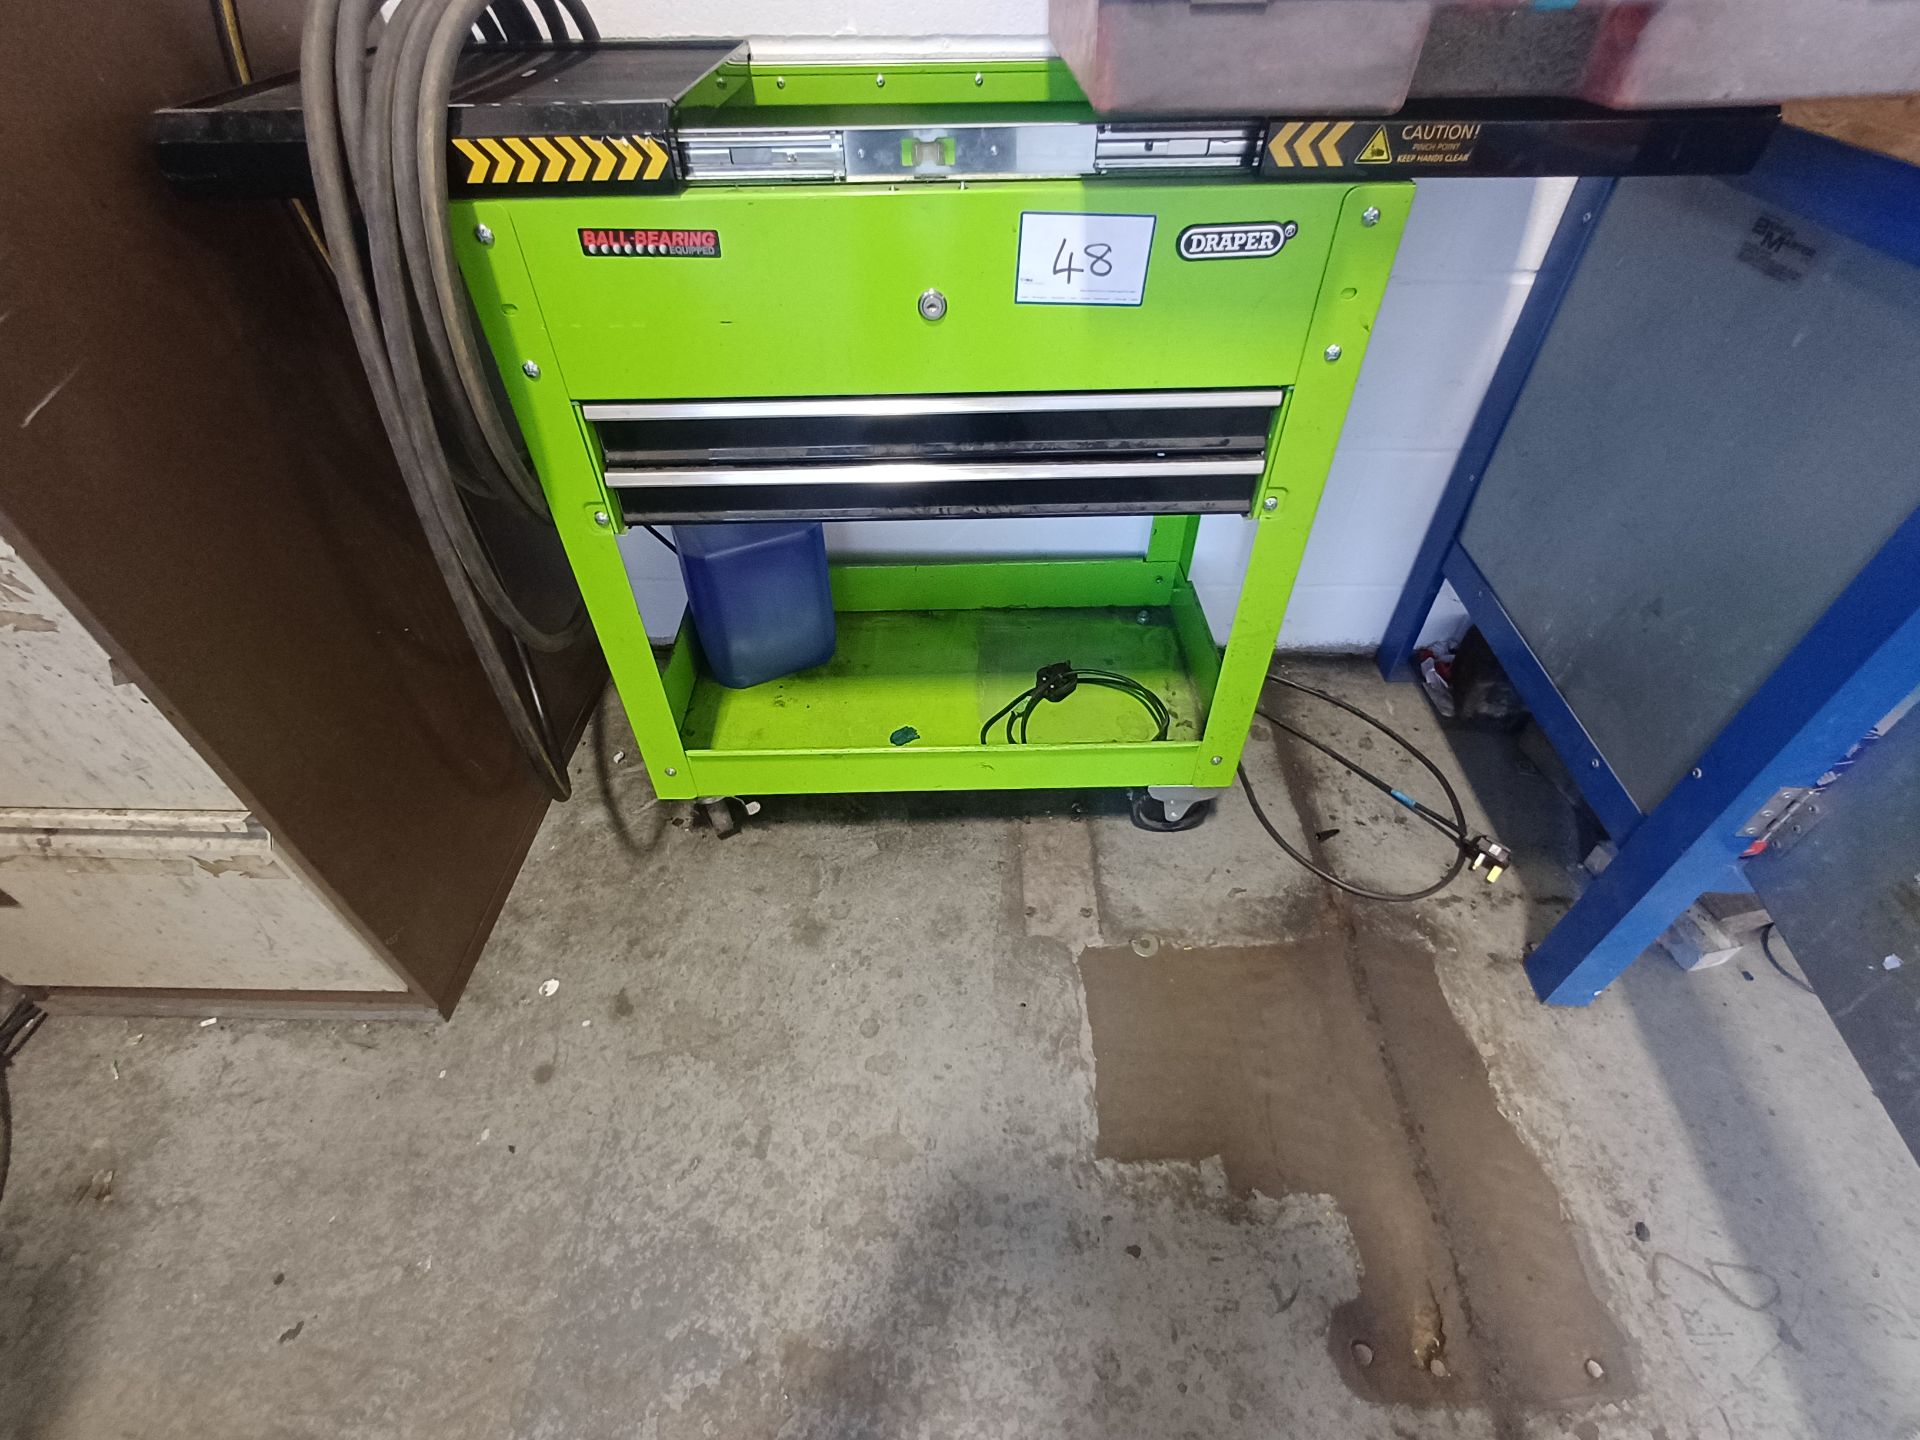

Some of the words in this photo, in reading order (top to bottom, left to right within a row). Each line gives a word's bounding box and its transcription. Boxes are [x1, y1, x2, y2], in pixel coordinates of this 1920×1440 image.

[1402, 124, 1481, 140] CAUTION!
[1437, 143, 1460, 151] POINT
[1397, 154, 1416, 162] KEEP
[1417, 154, 1444, 162] HANDS
[583, 231, 715, 246] BALL-BEARING
[1188, 231, 1275, 253] DRAPER
[669, 245, 715, 255] EQUIPPED
[1053, 238, 1112, 284] 48
